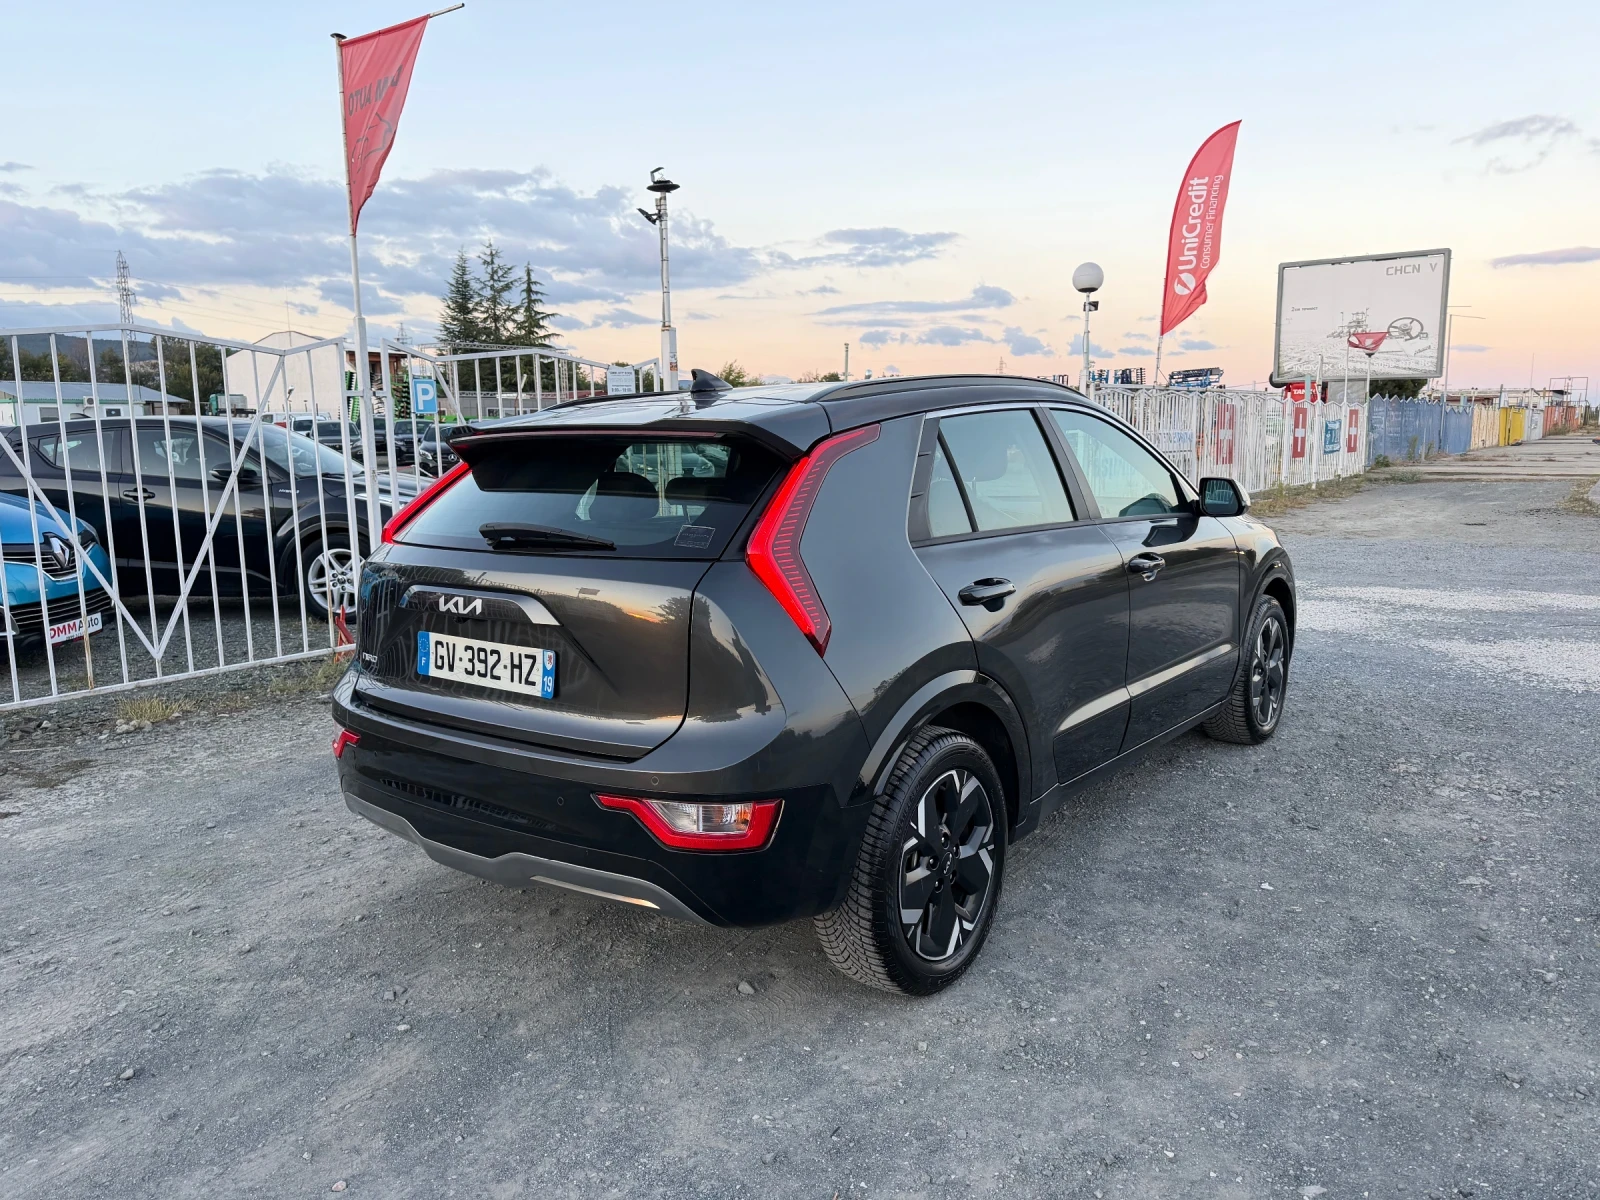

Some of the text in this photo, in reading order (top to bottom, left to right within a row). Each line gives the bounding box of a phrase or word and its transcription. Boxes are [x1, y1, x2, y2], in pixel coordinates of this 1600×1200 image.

[1177, 176, 1209, 271] UniCredit
[1200, 174, 1224, 269] Consumer Financing
[416, 383, 434, 410] P
[438, 595, 482, 615] KIA
[421, 657, 427, 666] F
[543, 675, 553, 693] 19
